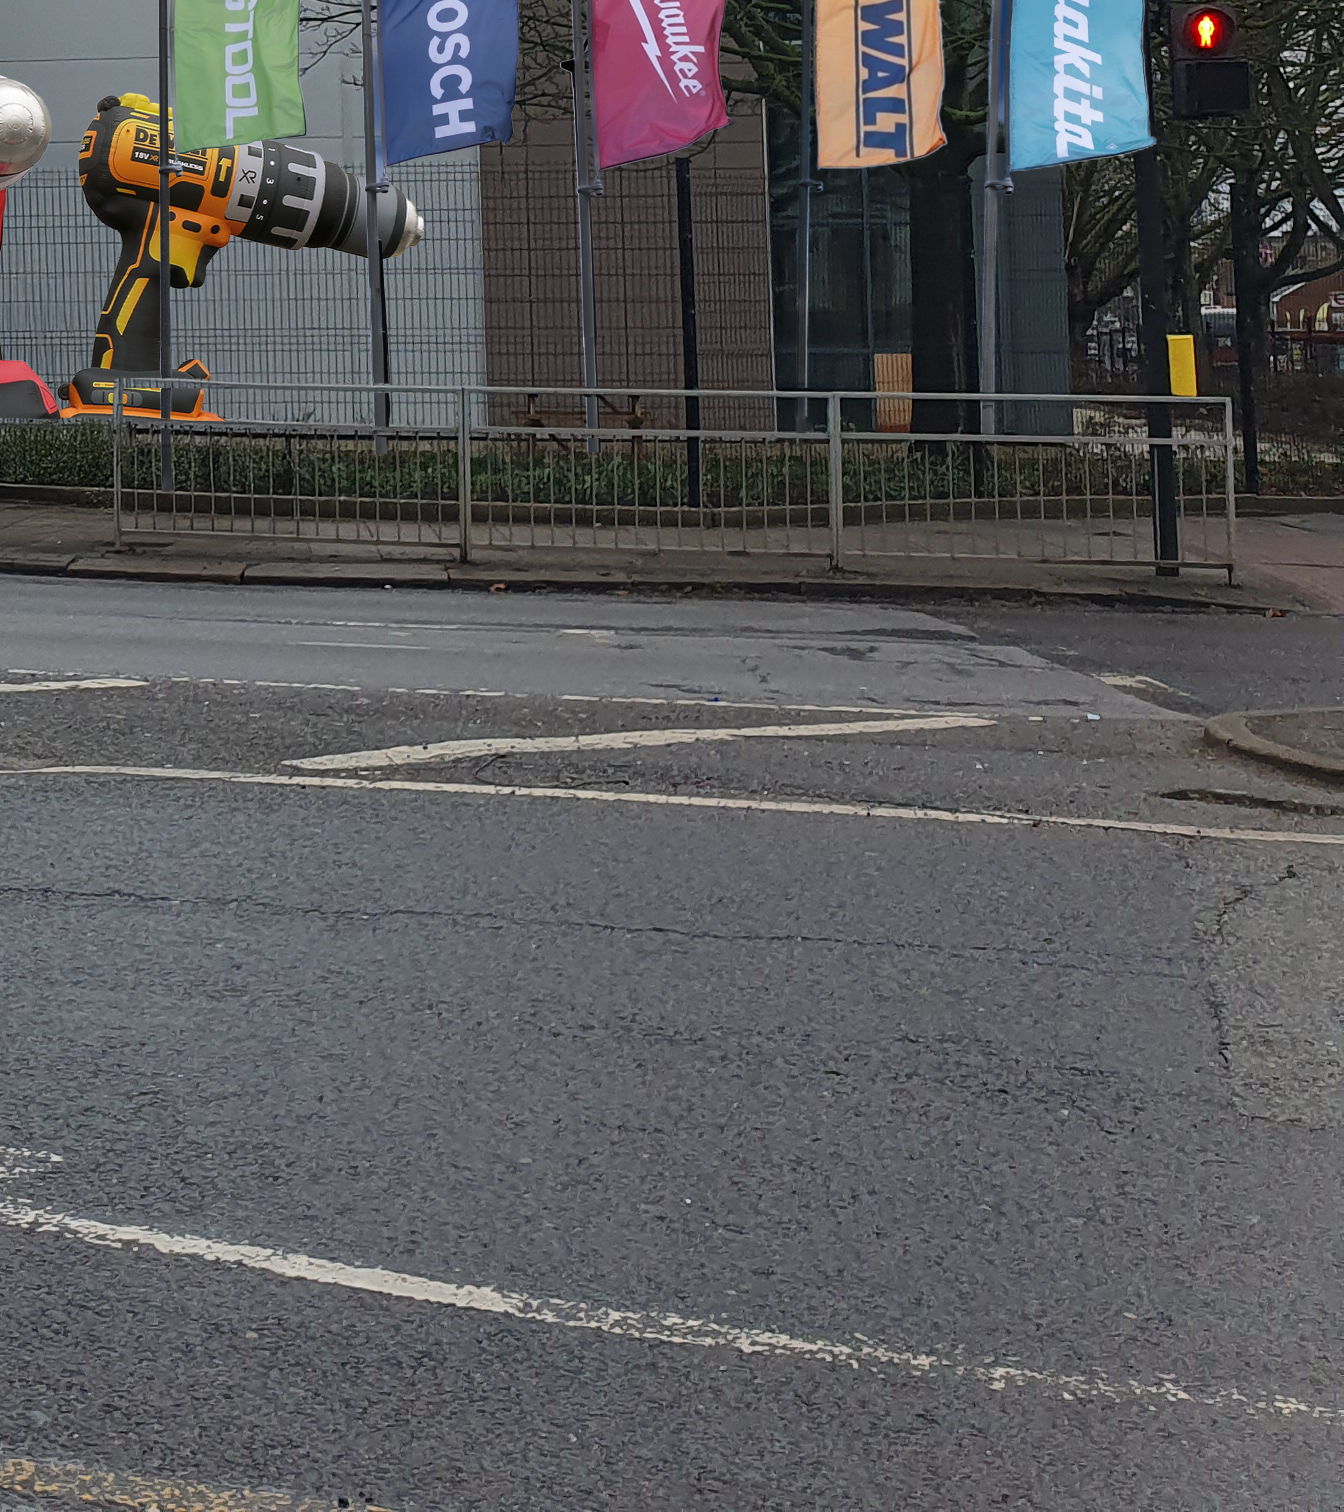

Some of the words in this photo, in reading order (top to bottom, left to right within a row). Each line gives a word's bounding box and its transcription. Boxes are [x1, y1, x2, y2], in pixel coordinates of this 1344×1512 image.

[134, 151, 150, 160] 18V
[239, 169, 257, 184] XR
[266, 177, 274, 185] 3
